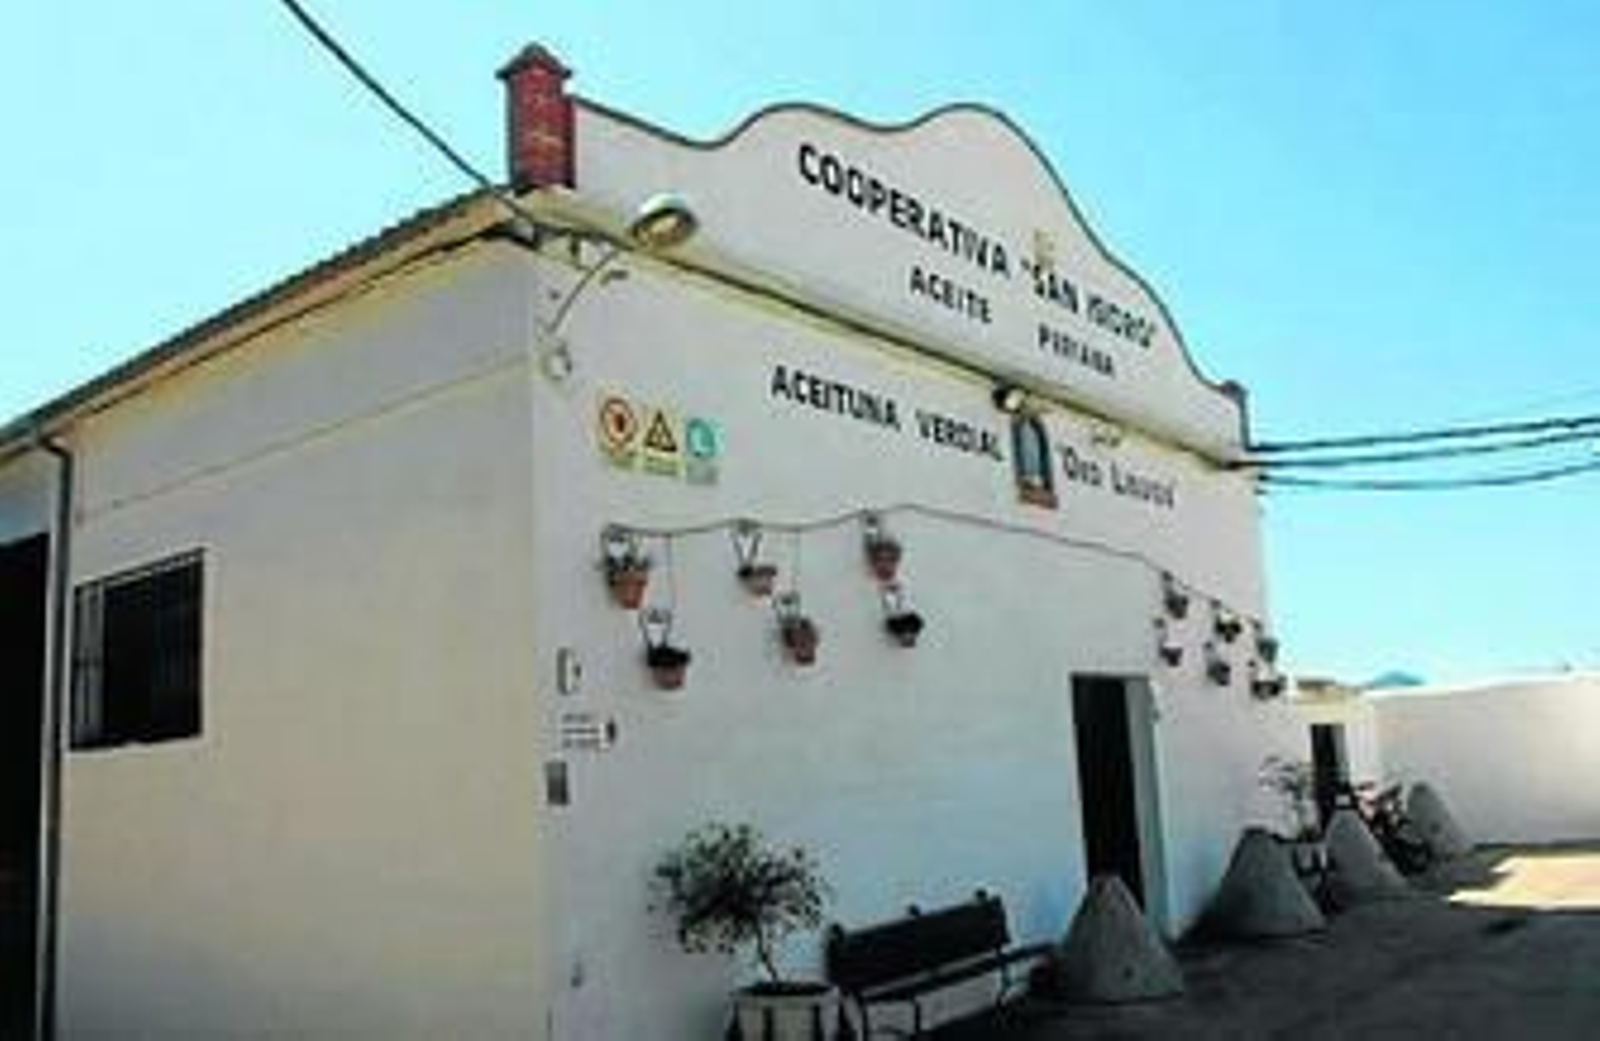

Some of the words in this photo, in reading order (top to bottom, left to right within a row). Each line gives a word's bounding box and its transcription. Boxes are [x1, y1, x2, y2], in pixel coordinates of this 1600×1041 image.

[797, 143, 1010, 280] COOPERATIVA
[910, 265, 994, 325] ACEITE
[770, 364, 901, 433] ACEITUNA
[915, 410, 1005, 463] VERDIAL
